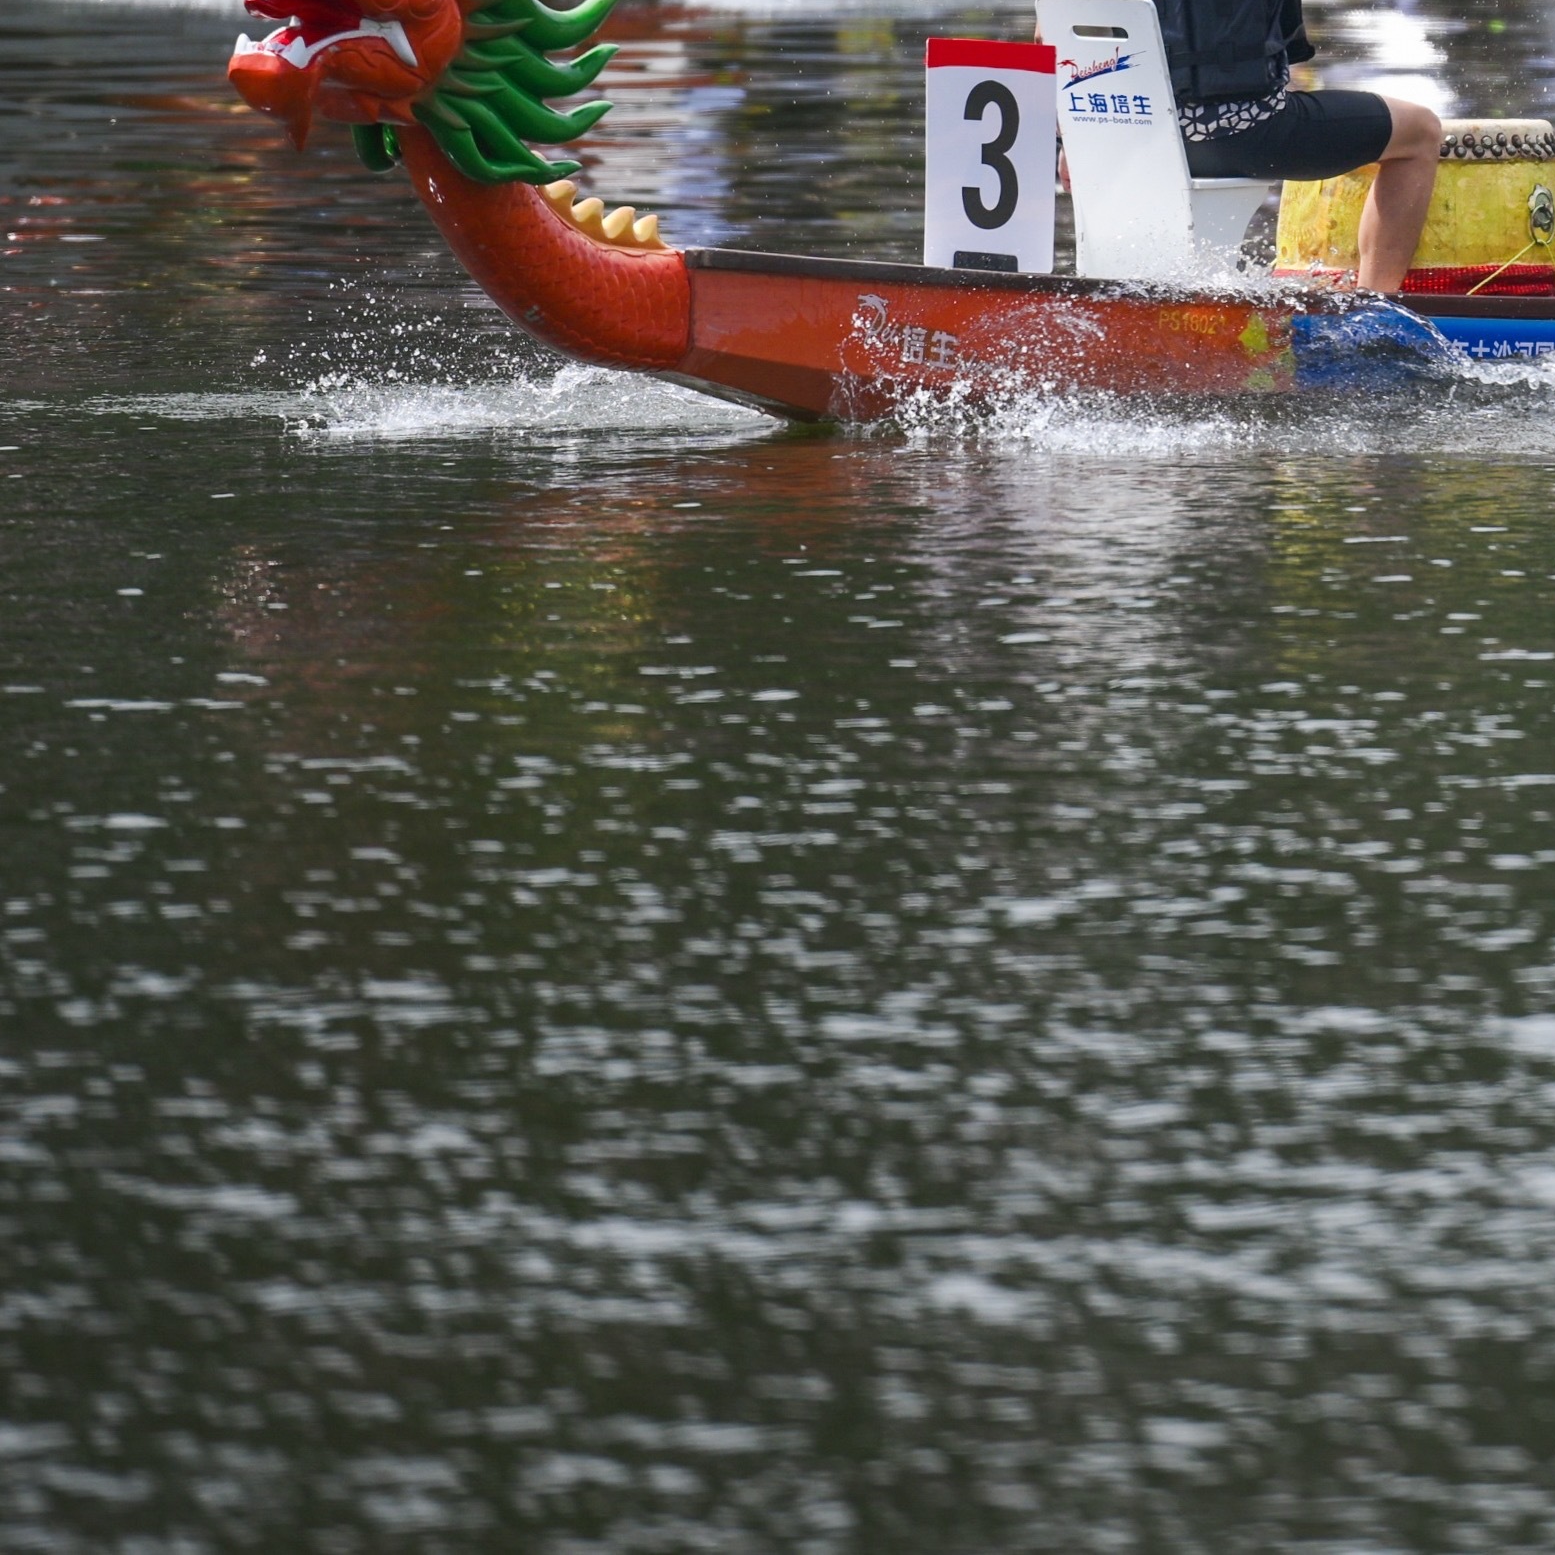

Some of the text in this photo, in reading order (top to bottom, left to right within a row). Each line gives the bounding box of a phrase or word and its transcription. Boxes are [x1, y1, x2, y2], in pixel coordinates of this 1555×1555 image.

[1068, 92, 1153, 116] 上海培生
[1072, 115, 1153, 126] www.ps-boat.com
[961, 80, 1020, 229] 3
